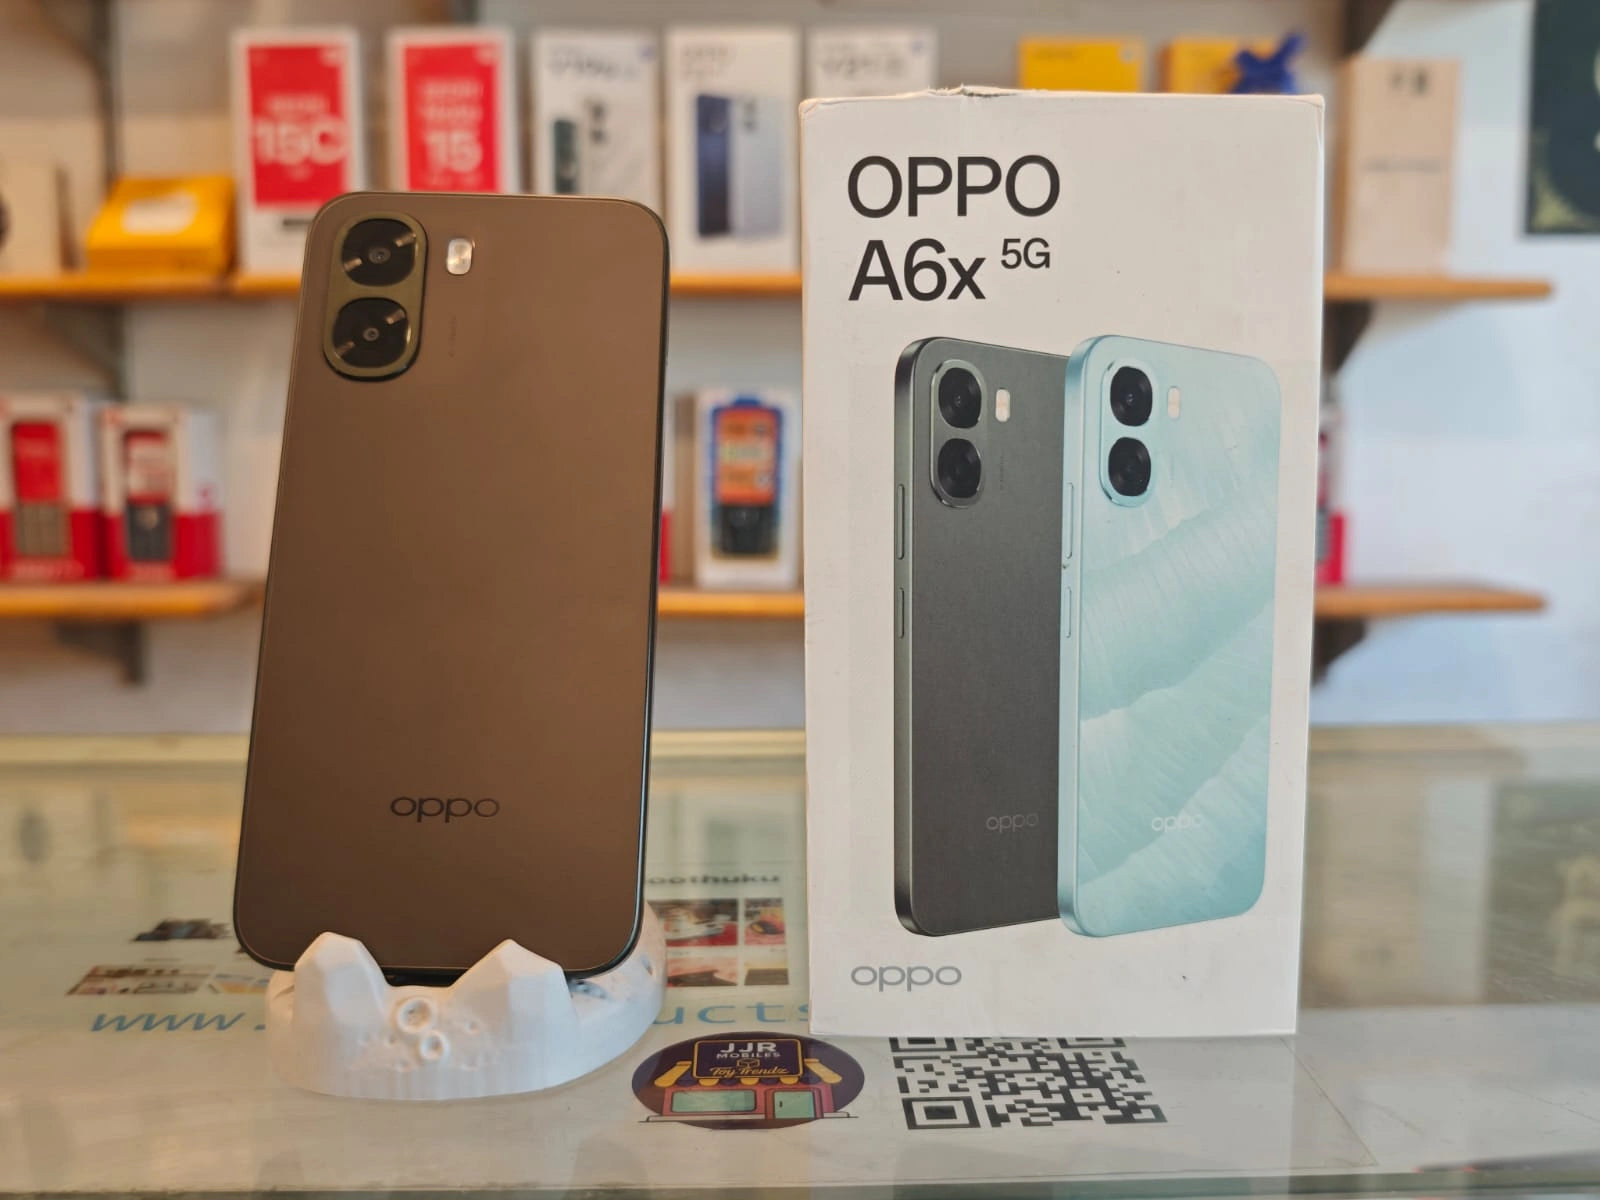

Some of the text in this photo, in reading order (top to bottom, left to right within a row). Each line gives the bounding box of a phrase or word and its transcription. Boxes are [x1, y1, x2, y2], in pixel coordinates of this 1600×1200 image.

[848, 154, 1061, 218] OPPO
[848, 237, 1051, 302] A6x 5G
[390, 796, 500, 823] oppo
[985, 813, 1039, 832] oppo
[850, 966, 962, 992] oppo
[719, 1042, 777, 1053] JJR
[709, 1066, 736, 1079] Toy
